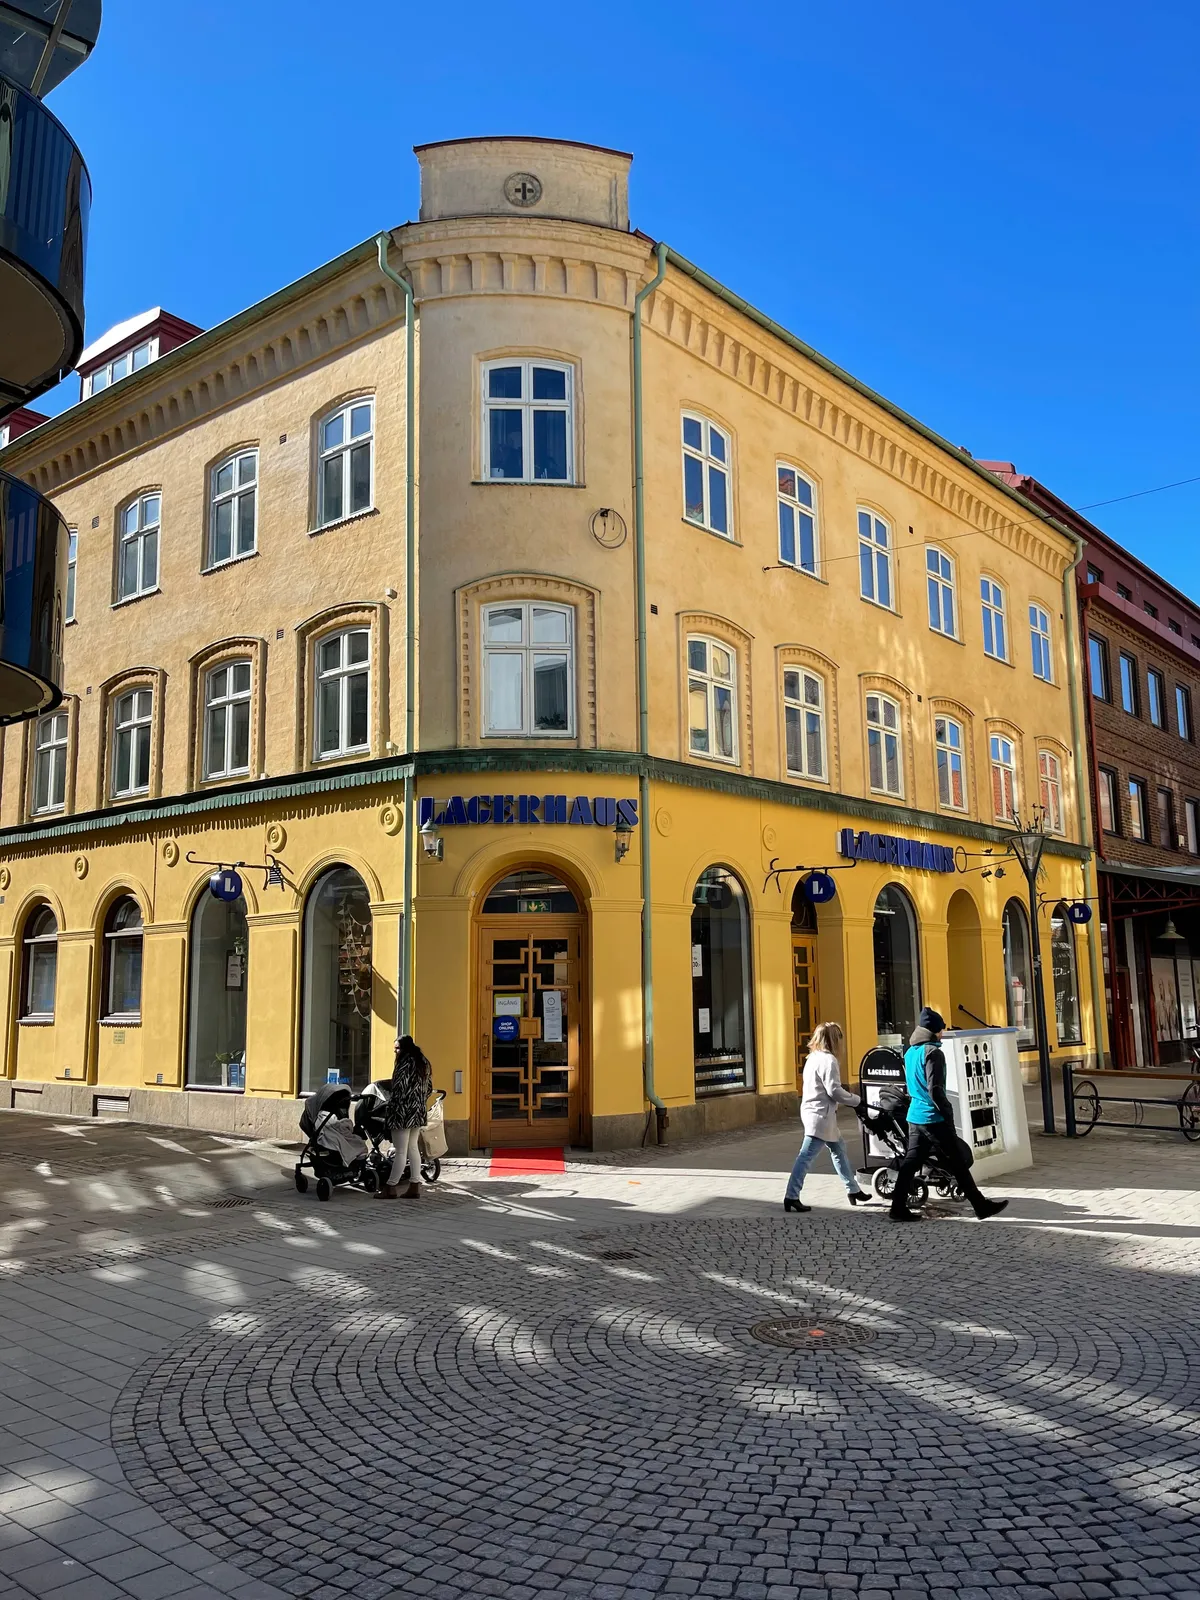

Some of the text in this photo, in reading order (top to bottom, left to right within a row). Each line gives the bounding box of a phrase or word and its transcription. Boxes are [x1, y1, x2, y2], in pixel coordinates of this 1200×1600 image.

[419, 795, 639, 826] LAGERHAUS
[841, 828, 955, 873] LAGERHAUS
[224, 877, 236, 893] L
[812, 880, 824, 895] L
[1074, 907, 1084, 918] L
